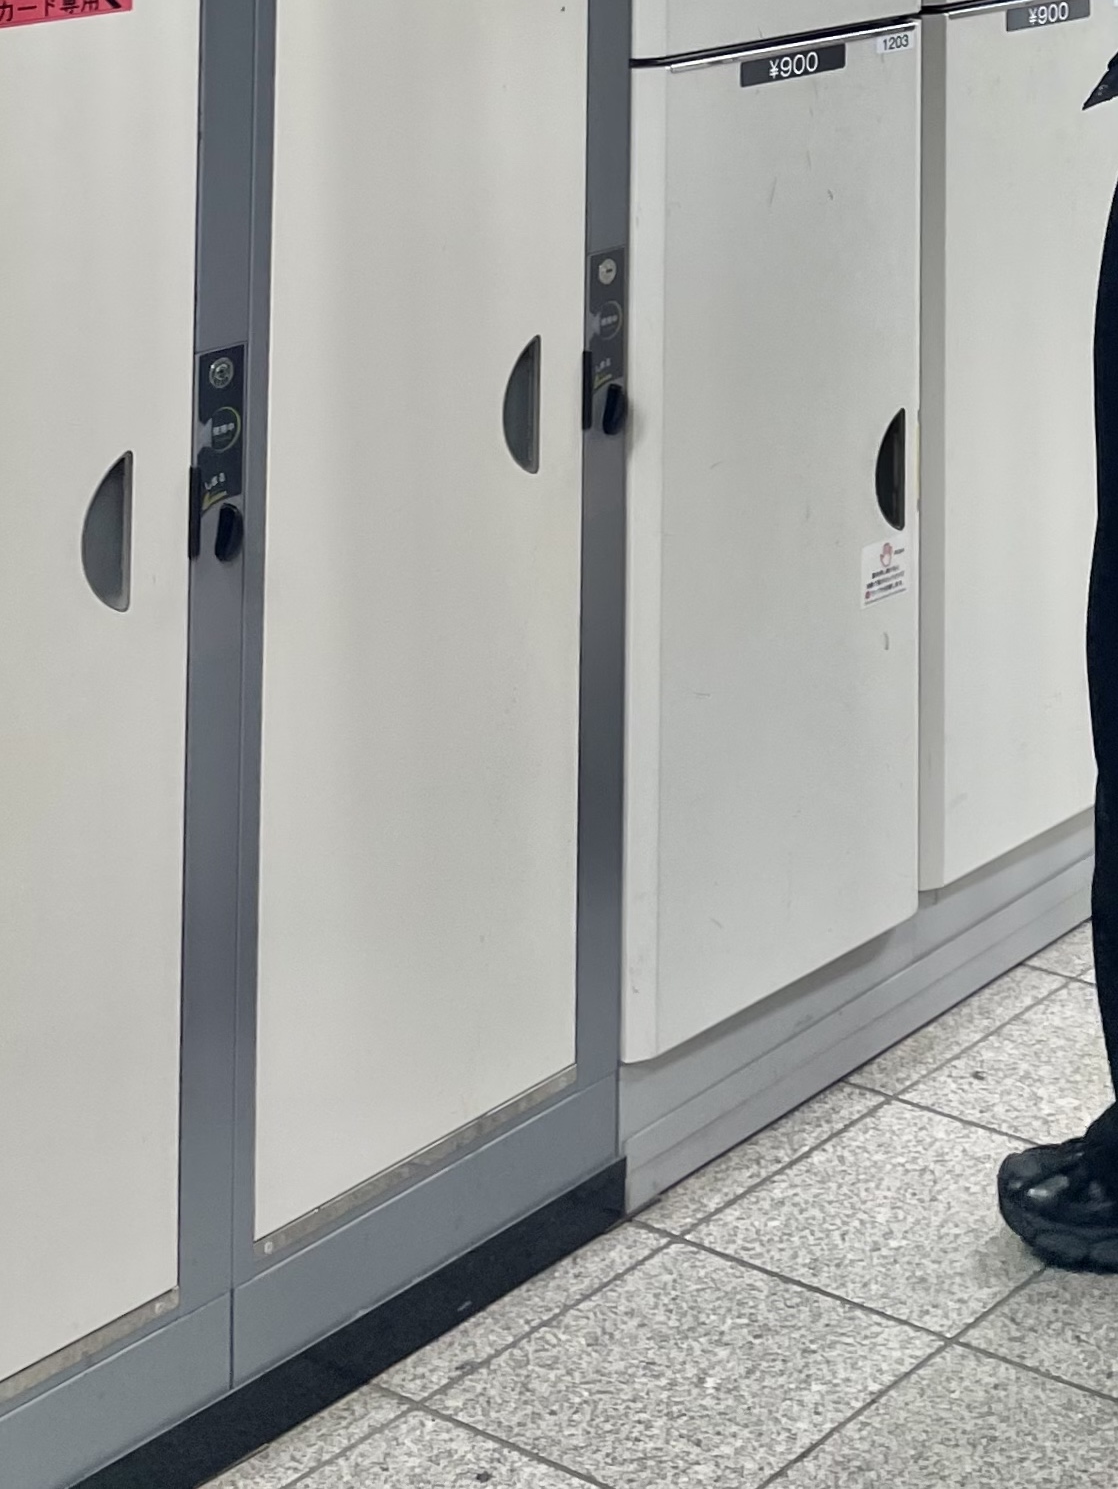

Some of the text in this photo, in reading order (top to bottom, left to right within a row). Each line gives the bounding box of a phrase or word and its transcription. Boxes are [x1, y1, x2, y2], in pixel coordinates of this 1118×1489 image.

[1029, 1, 1069, 25] ¥900
[883, 34, 909, 51] 1203
[769, 51, 818, 79] ¥900
